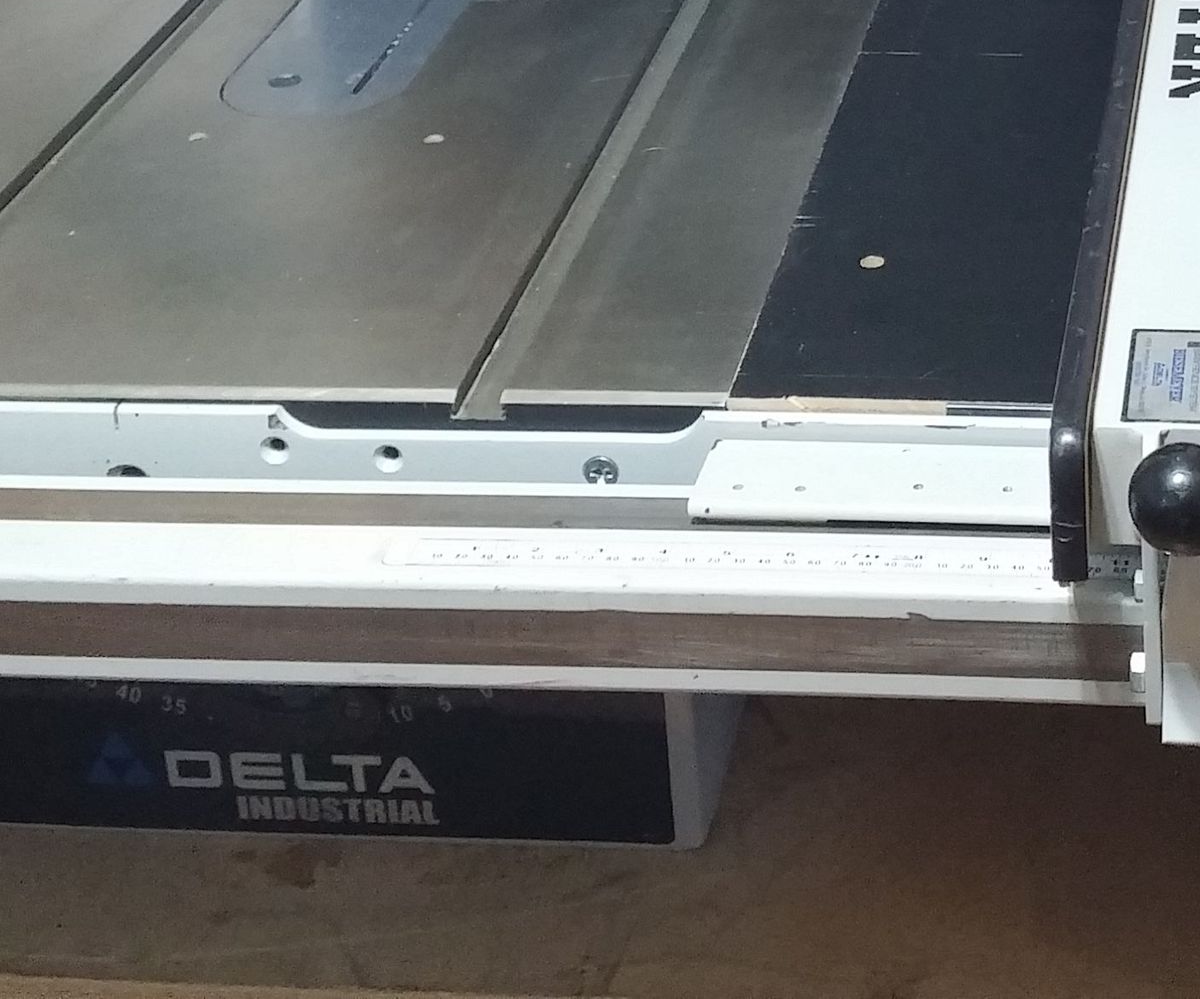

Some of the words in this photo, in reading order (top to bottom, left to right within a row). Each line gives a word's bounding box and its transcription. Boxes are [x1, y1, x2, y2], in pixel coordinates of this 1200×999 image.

[115, 684, 141, 704] 40
[161, 695, 187, 715] 35
[388, 704, 414, 723] 10
[438, 694, 453, 713] 5
[163, 750, 436, 794] DELTA
[236, 795, 440, 826] INDUSTRIAL
